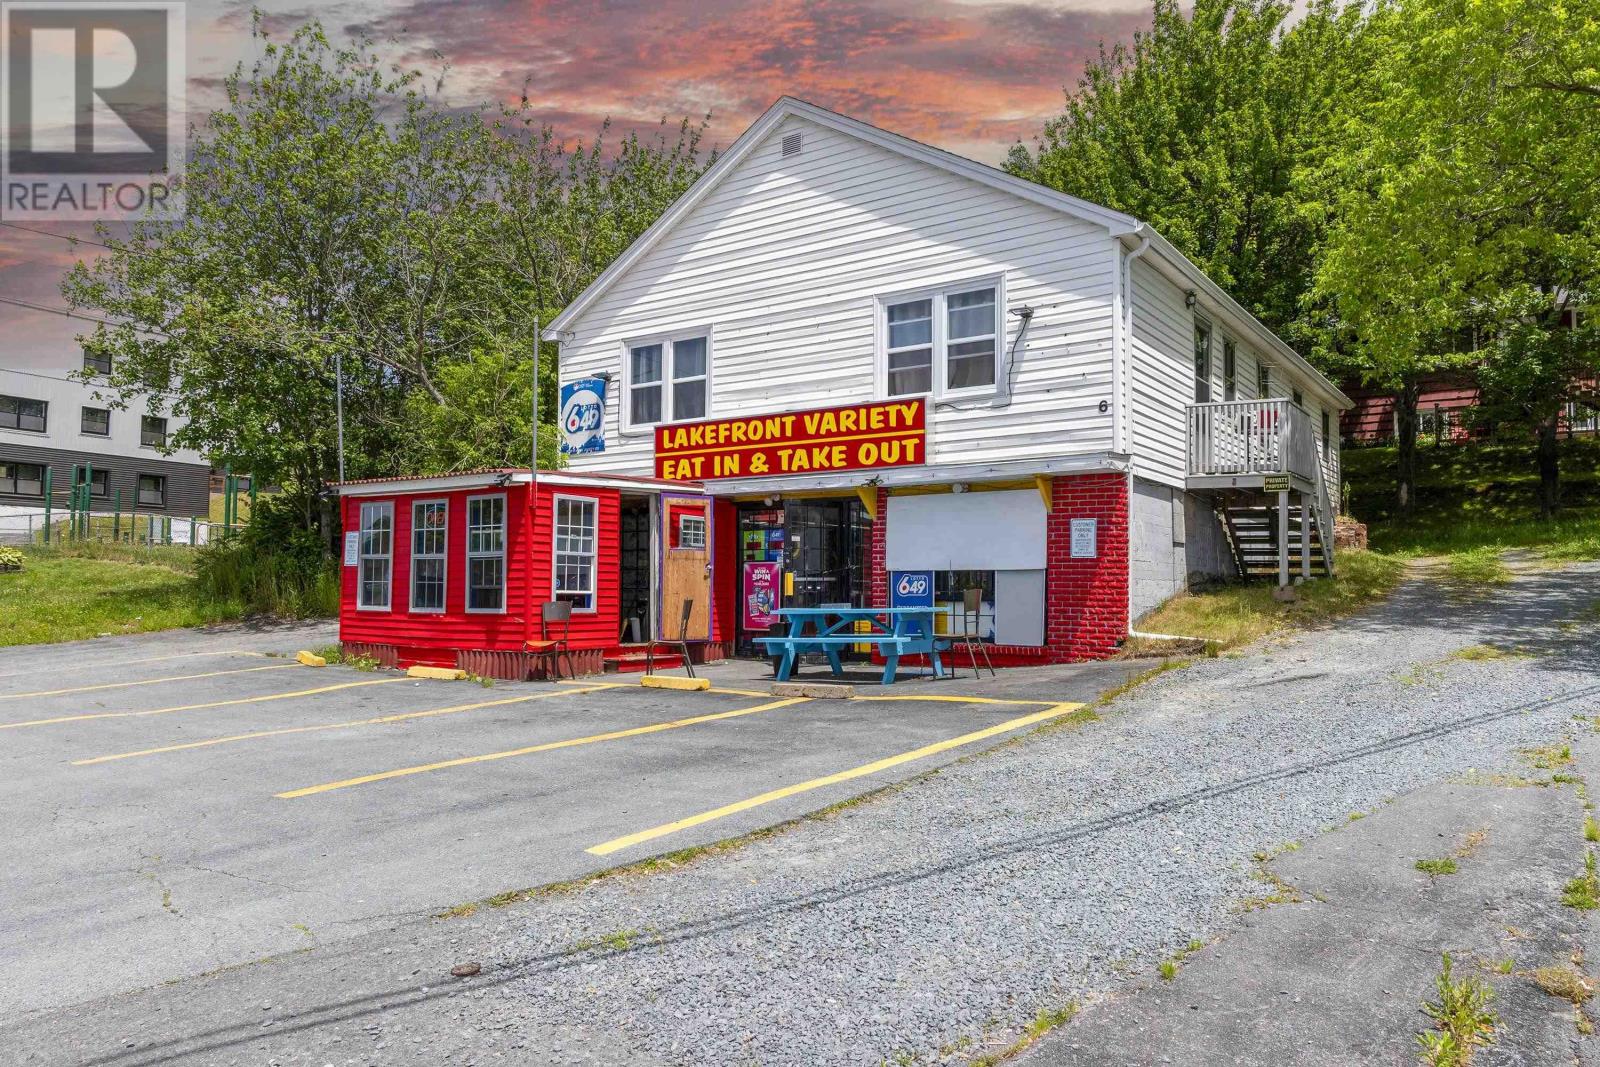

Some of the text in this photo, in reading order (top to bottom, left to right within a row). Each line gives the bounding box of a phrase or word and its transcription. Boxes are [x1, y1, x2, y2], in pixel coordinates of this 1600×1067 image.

[1099, 400, 1108, 413] 6
[663, 401, 919, 449] LAKEFRONT VARIETY
[663, 438, 920, 480] EAT IN & TAKE OUT
[752, 573, 771, 581] SPIN
